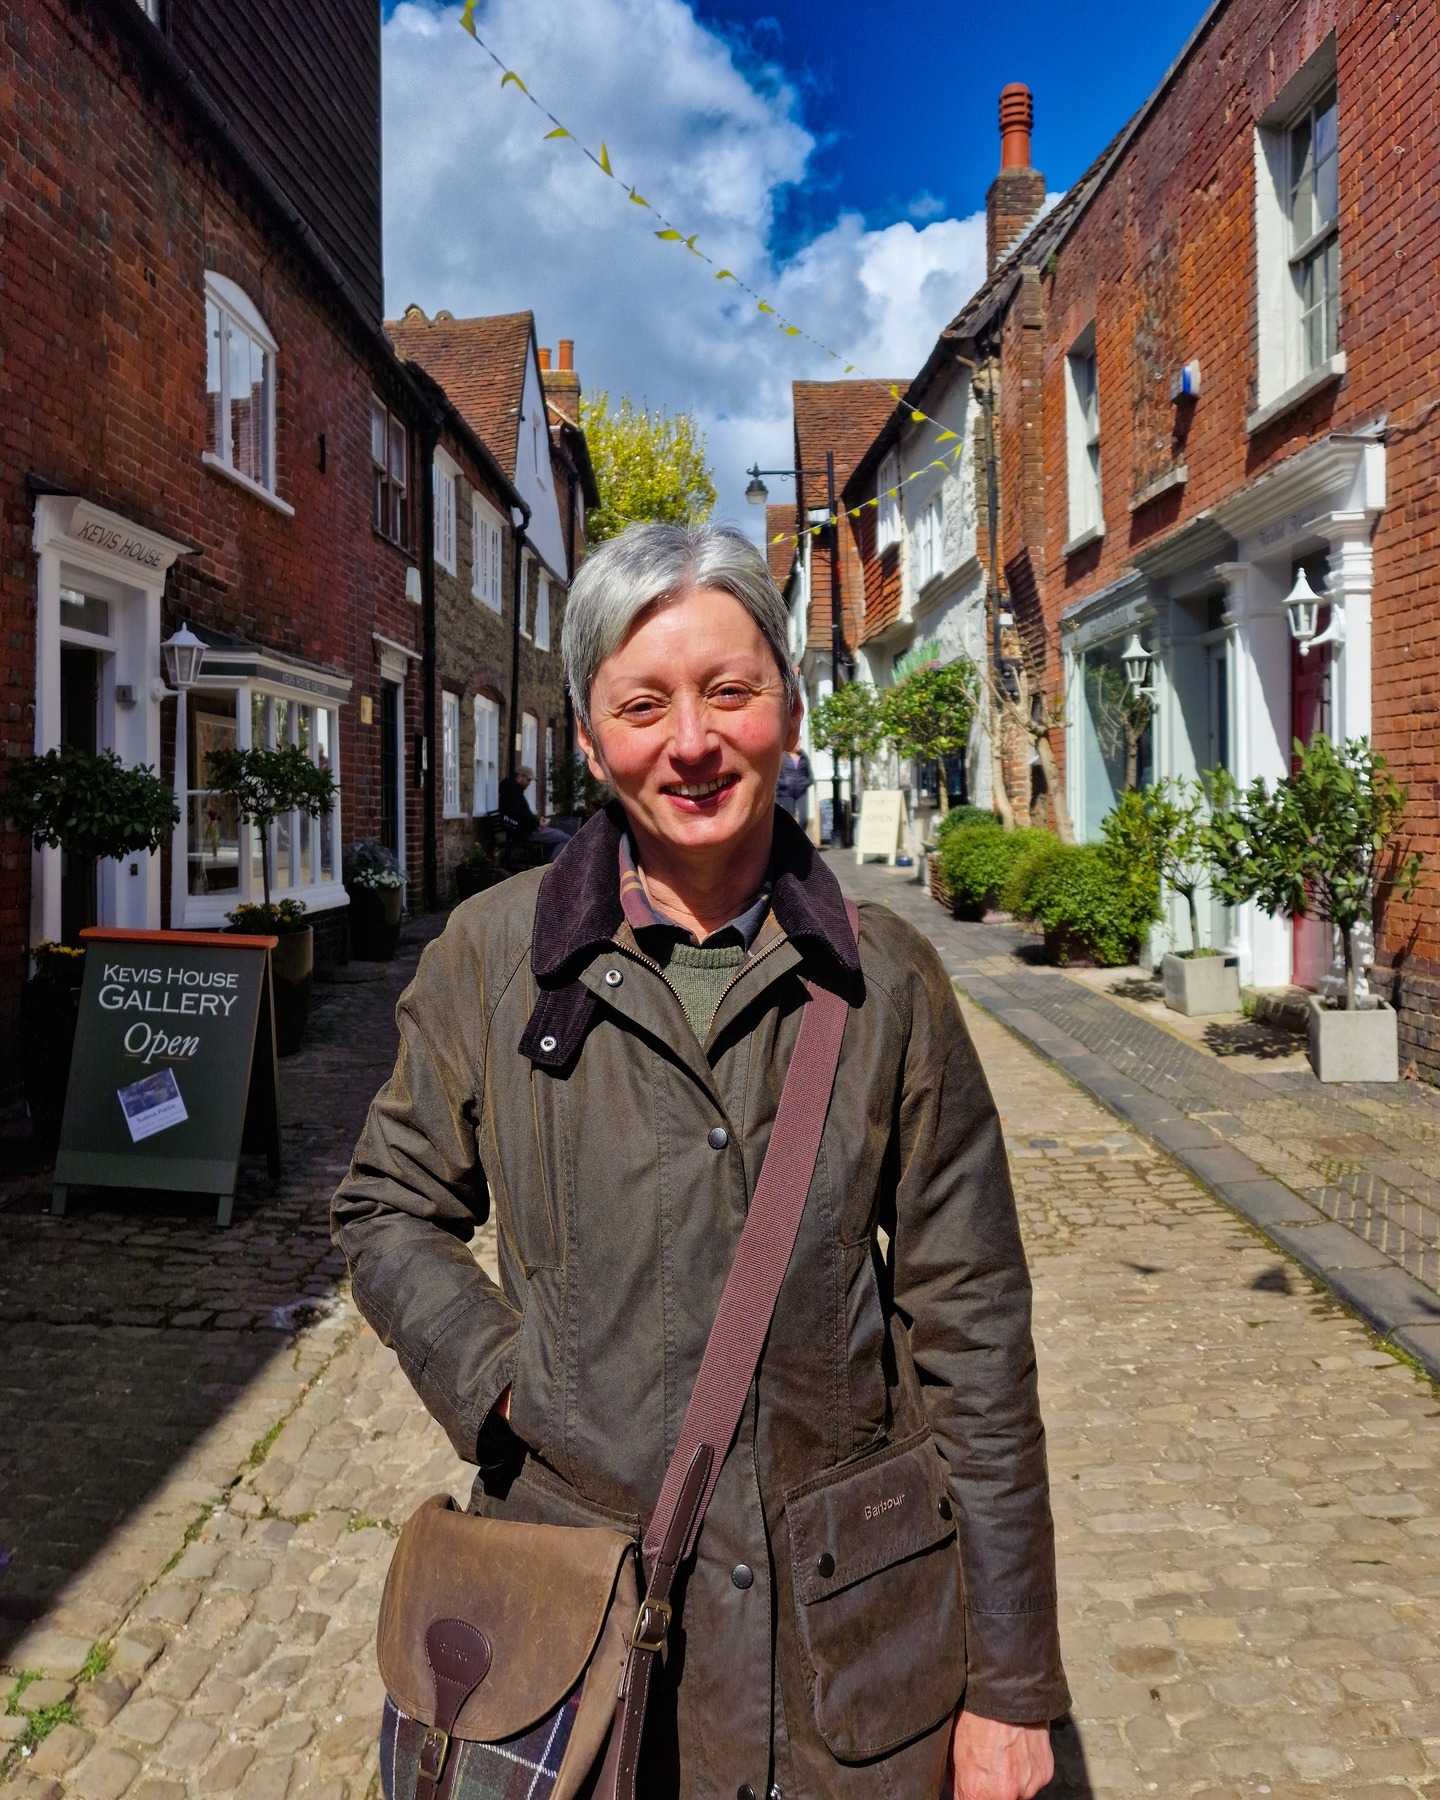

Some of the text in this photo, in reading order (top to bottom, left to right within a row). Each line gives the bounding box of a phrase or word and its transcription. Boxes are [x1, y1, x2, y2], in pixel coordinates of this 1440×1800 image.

[78, 520, 164, 567] KEVIS HOUSE
[102, 964, 239, 988] KEVIS HOUSE
[98, 984, 239, 1016] GALLERY
[123, 1022, 200, 1064] Open
[864, 1493, 906, 1520] Barbour
